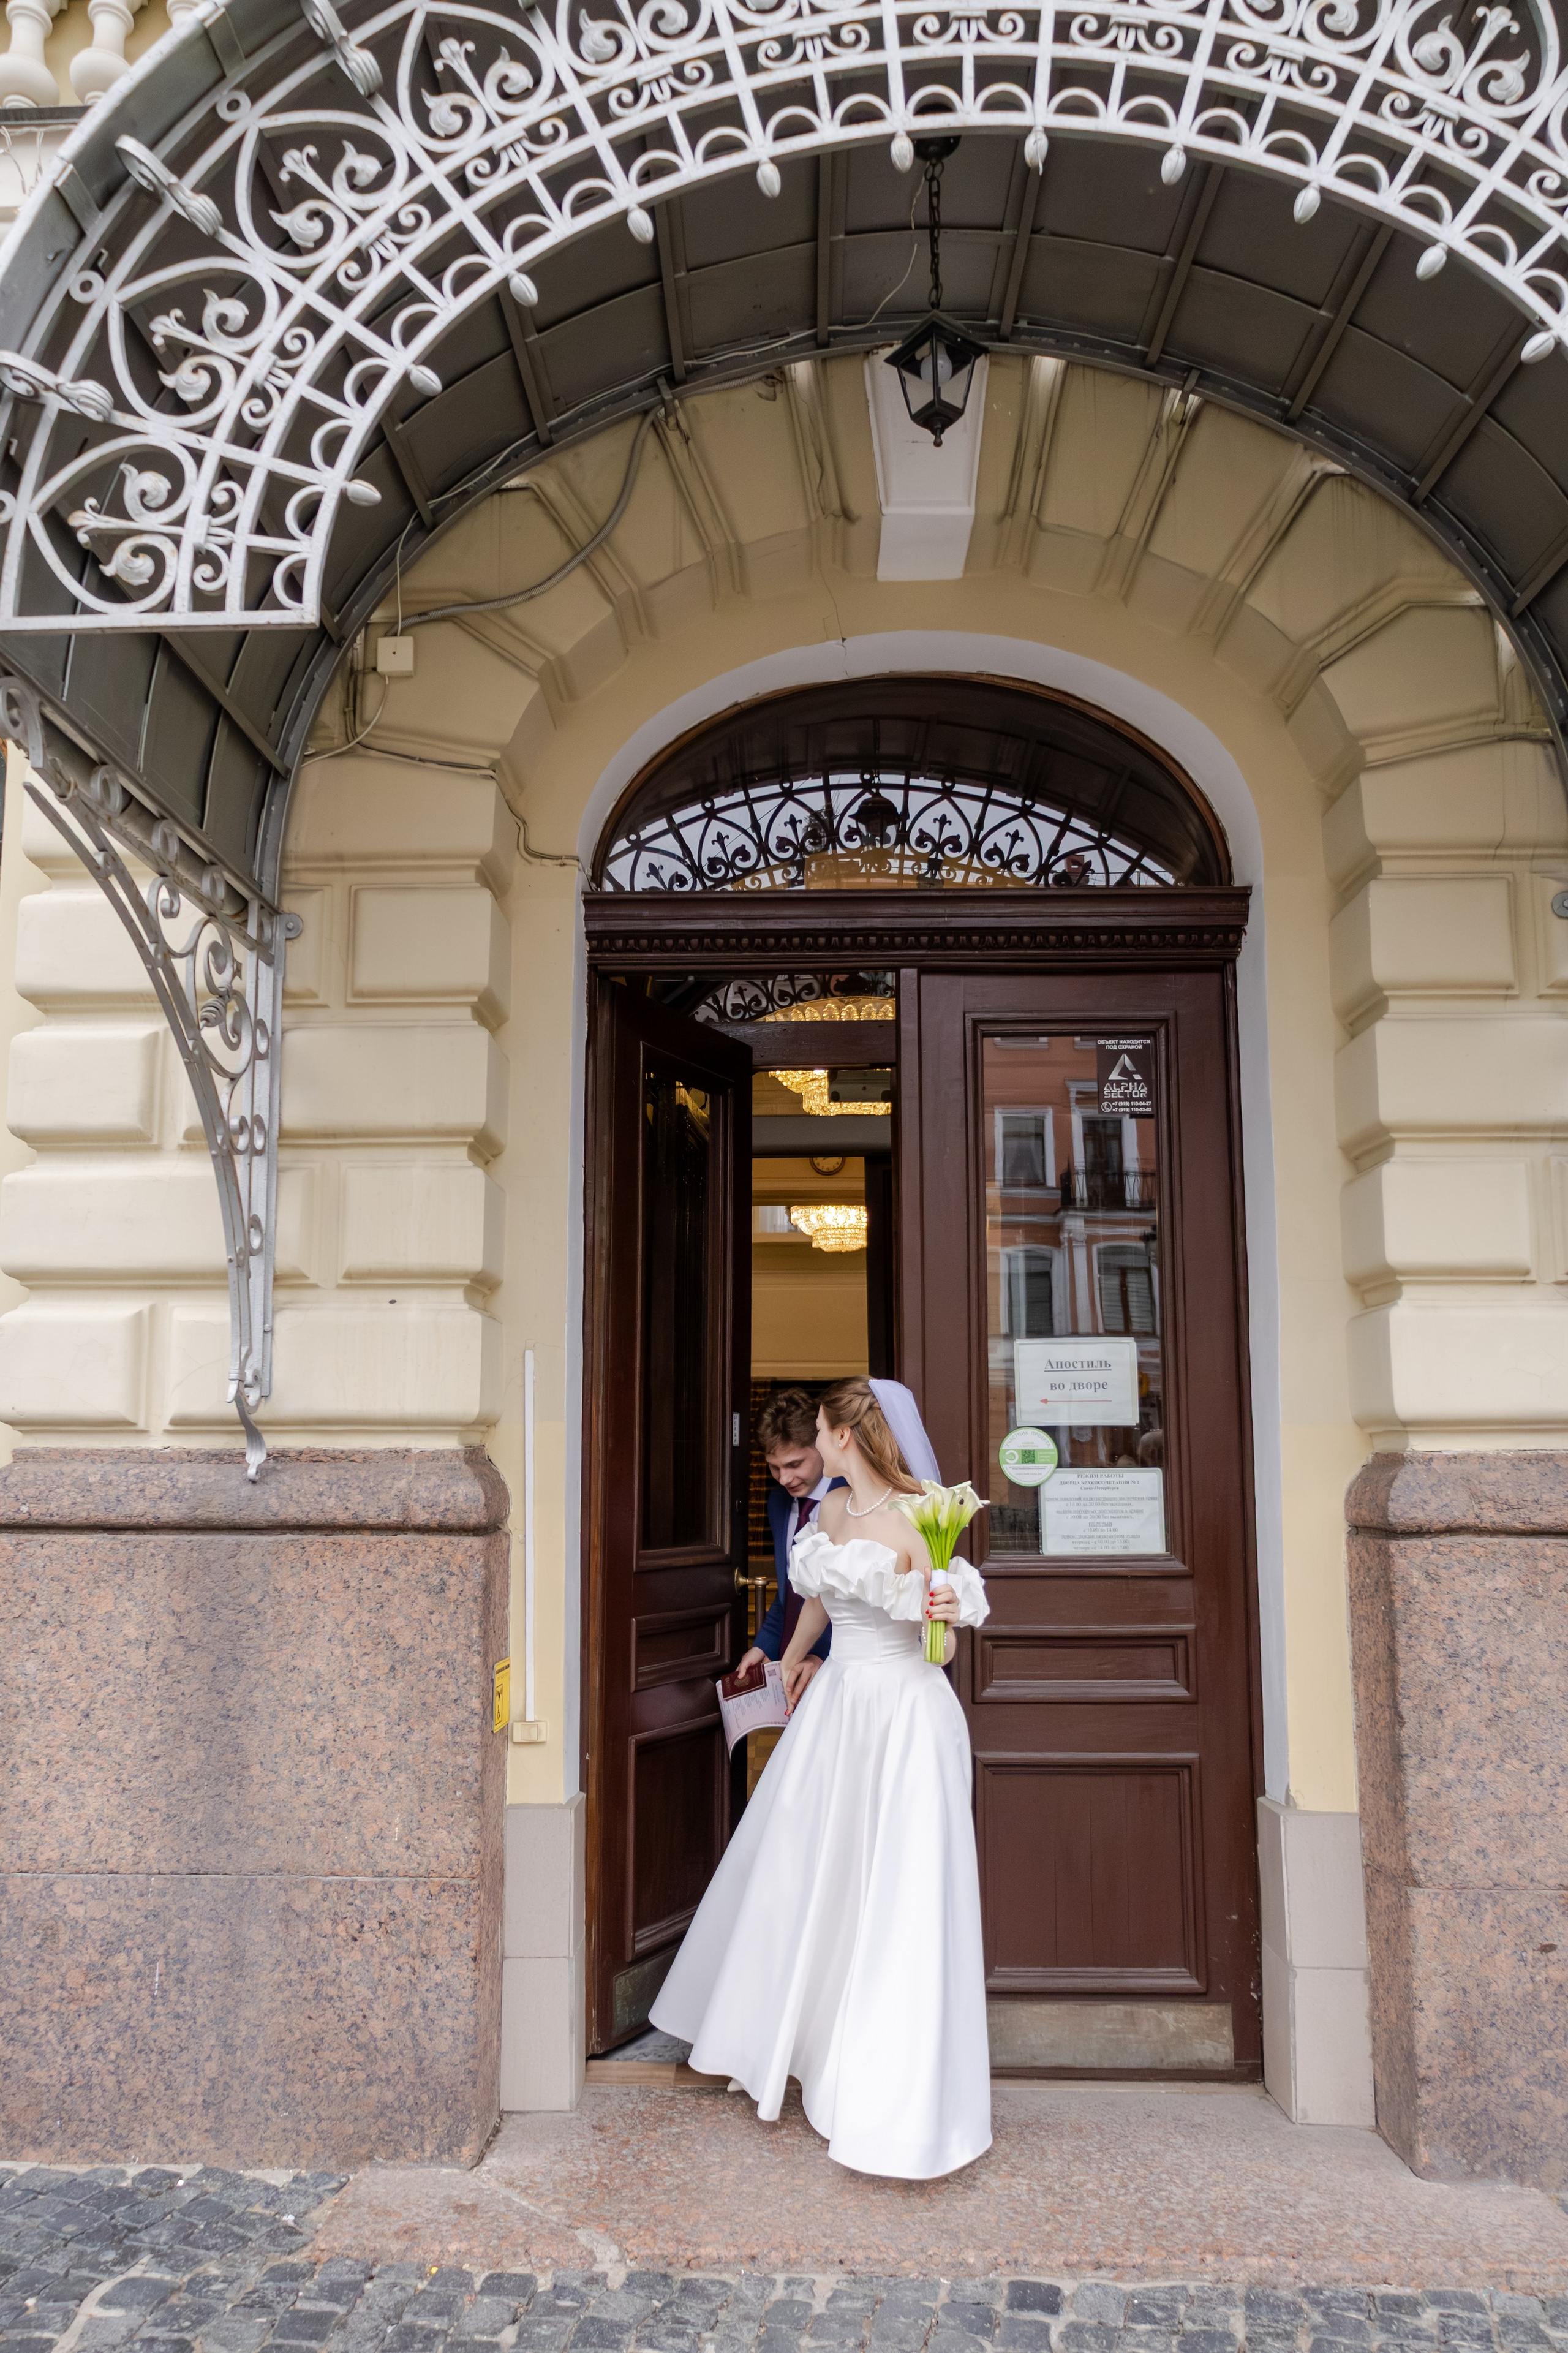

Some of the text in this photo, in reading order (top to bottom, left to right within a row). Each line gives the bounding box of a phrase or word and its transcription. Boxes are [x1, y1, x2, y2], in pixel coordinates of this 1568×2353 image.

[1044, 1359, 1112, 1371] Апостиль
[1050, 1381, 1108, 1392] во дворе
[1005, 1430, 1051, 1448] УЧАСТНИК ПРОЕКТА
